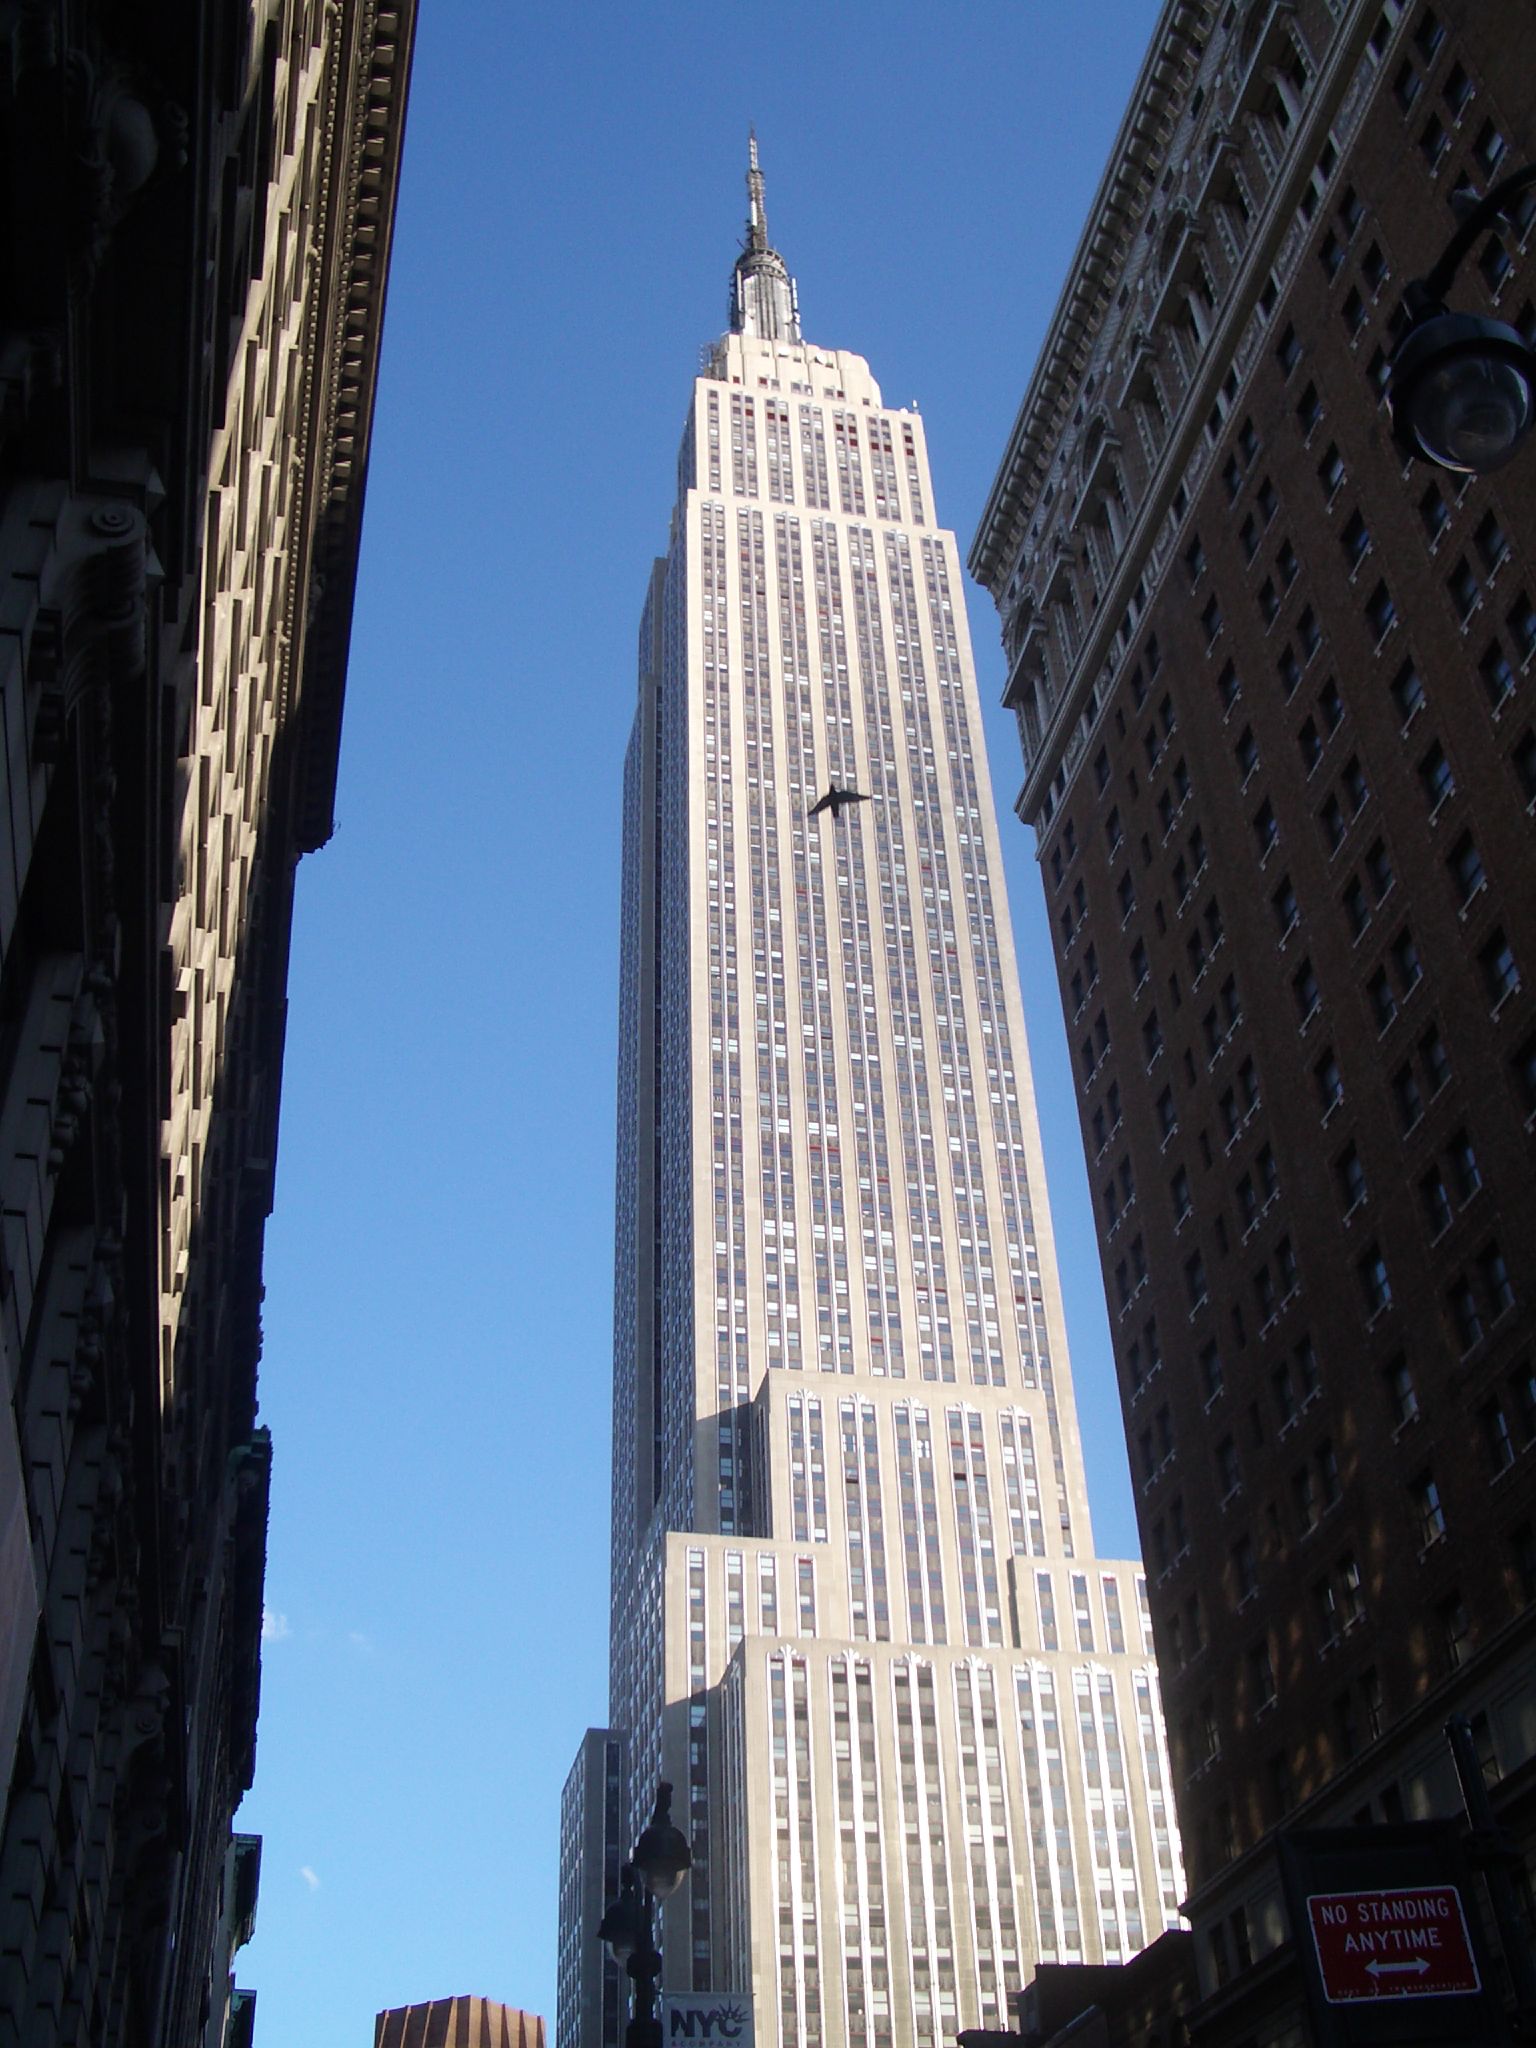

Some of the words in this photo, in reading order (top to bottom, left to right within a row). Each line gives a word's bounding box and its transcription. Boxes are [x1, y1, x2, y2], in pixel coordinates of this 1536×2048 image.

[1320, 1904, 1348, 1925] NO
[1357, 1897, 1449, 1923] STANDING
[1344, 1927, 1443, 1953] ANYTIME
[671, 2000, 750, 2037] NYC
